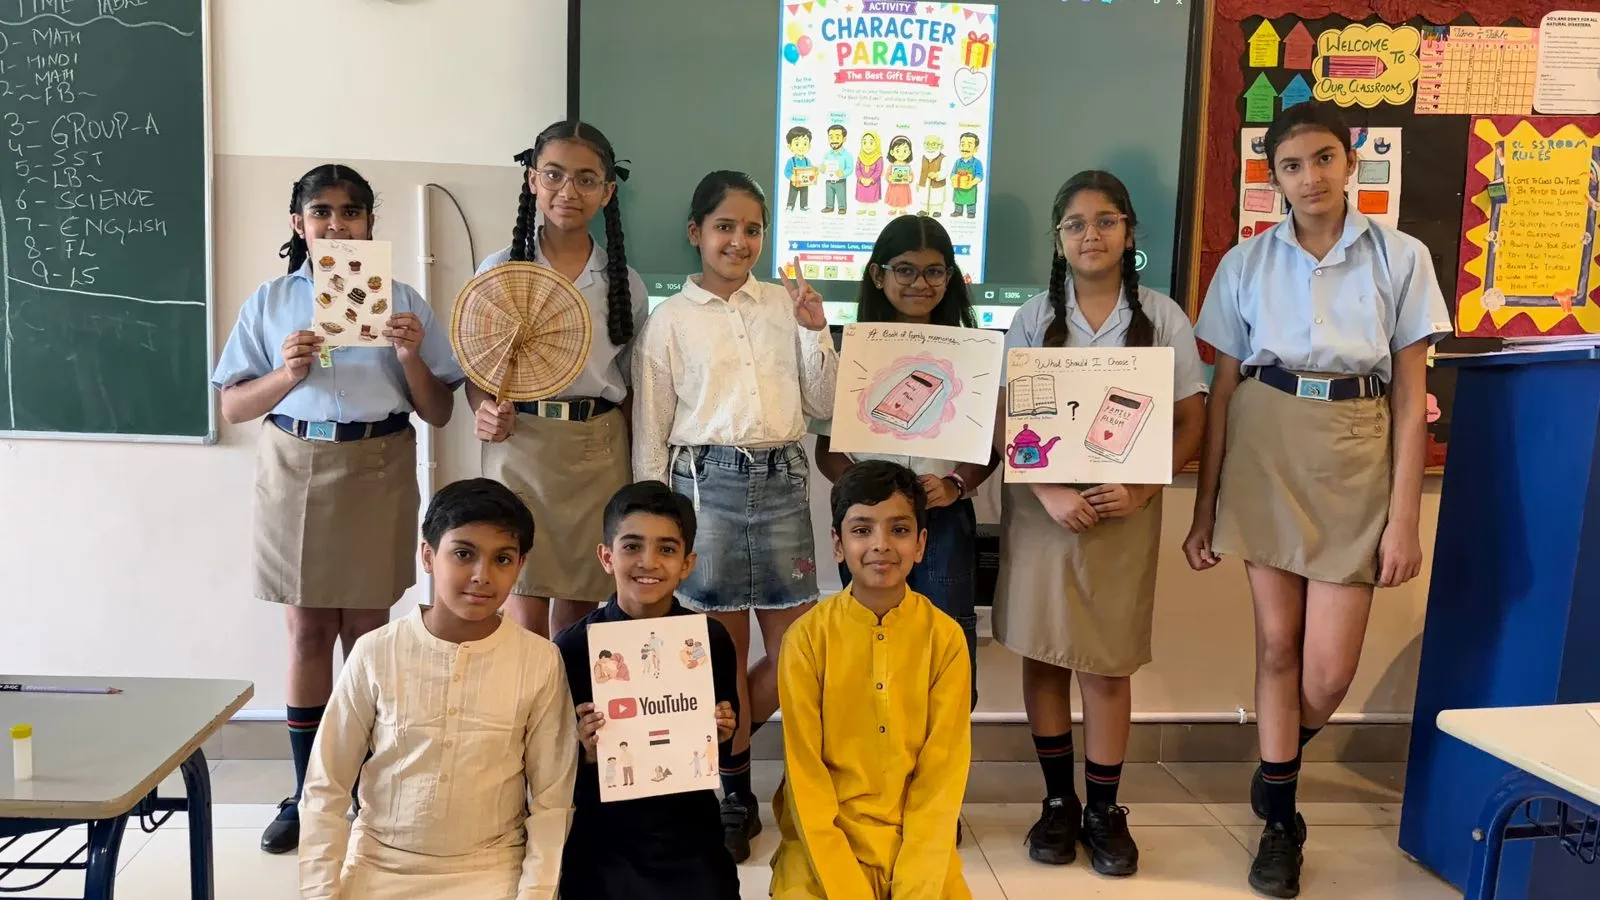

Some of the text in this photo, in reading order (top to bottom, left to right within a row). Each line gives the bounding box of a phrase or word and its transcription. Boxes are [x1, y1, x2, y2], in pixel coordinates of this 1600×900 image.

[869, 1, 911, 12] ACTIVITY
[32, 27, 81, 48] MATH
[821, 17, 956, 45] CHARACTER
[1326, 36, 1389, 52] WELCOME
[27, 53, 78, 70] HINDI
[836, 41, 943, 70] PARADE
[35, 69, 74, 88] MATH
[847, 71, 929, 82] The Best Gift Ever!
[1321, 78, 1405, 96] OUR CLASSROOM
[51, 112, 160, 148] GROUP-A
[52, 149, 103, 167] SST
[1513, 176, 1529, 185] COME
[1565, 176, 1581, 185] TIME
[55, 188, 155, 210] SCIENCE
[60, 216, 167, 245] ENGLISH
[65, 239, 97, 259] FL
[70, 266, 100, 287] LS
[867, 328, 877, 339] A
[882, 330, 898, 338] Book
[899, 330, 907, 338] of
[908, 330, 926, 343] family
[1034, 358, 1061, 369] What
[1065, 358, 1088, 368] Should
[1092, 358, 1101, 366] I
[1101, 414, 1125, 427] ALBUM
[1103, 406, 1131, 418] FAMILY
[639, 693, 698, 716] YouTube
